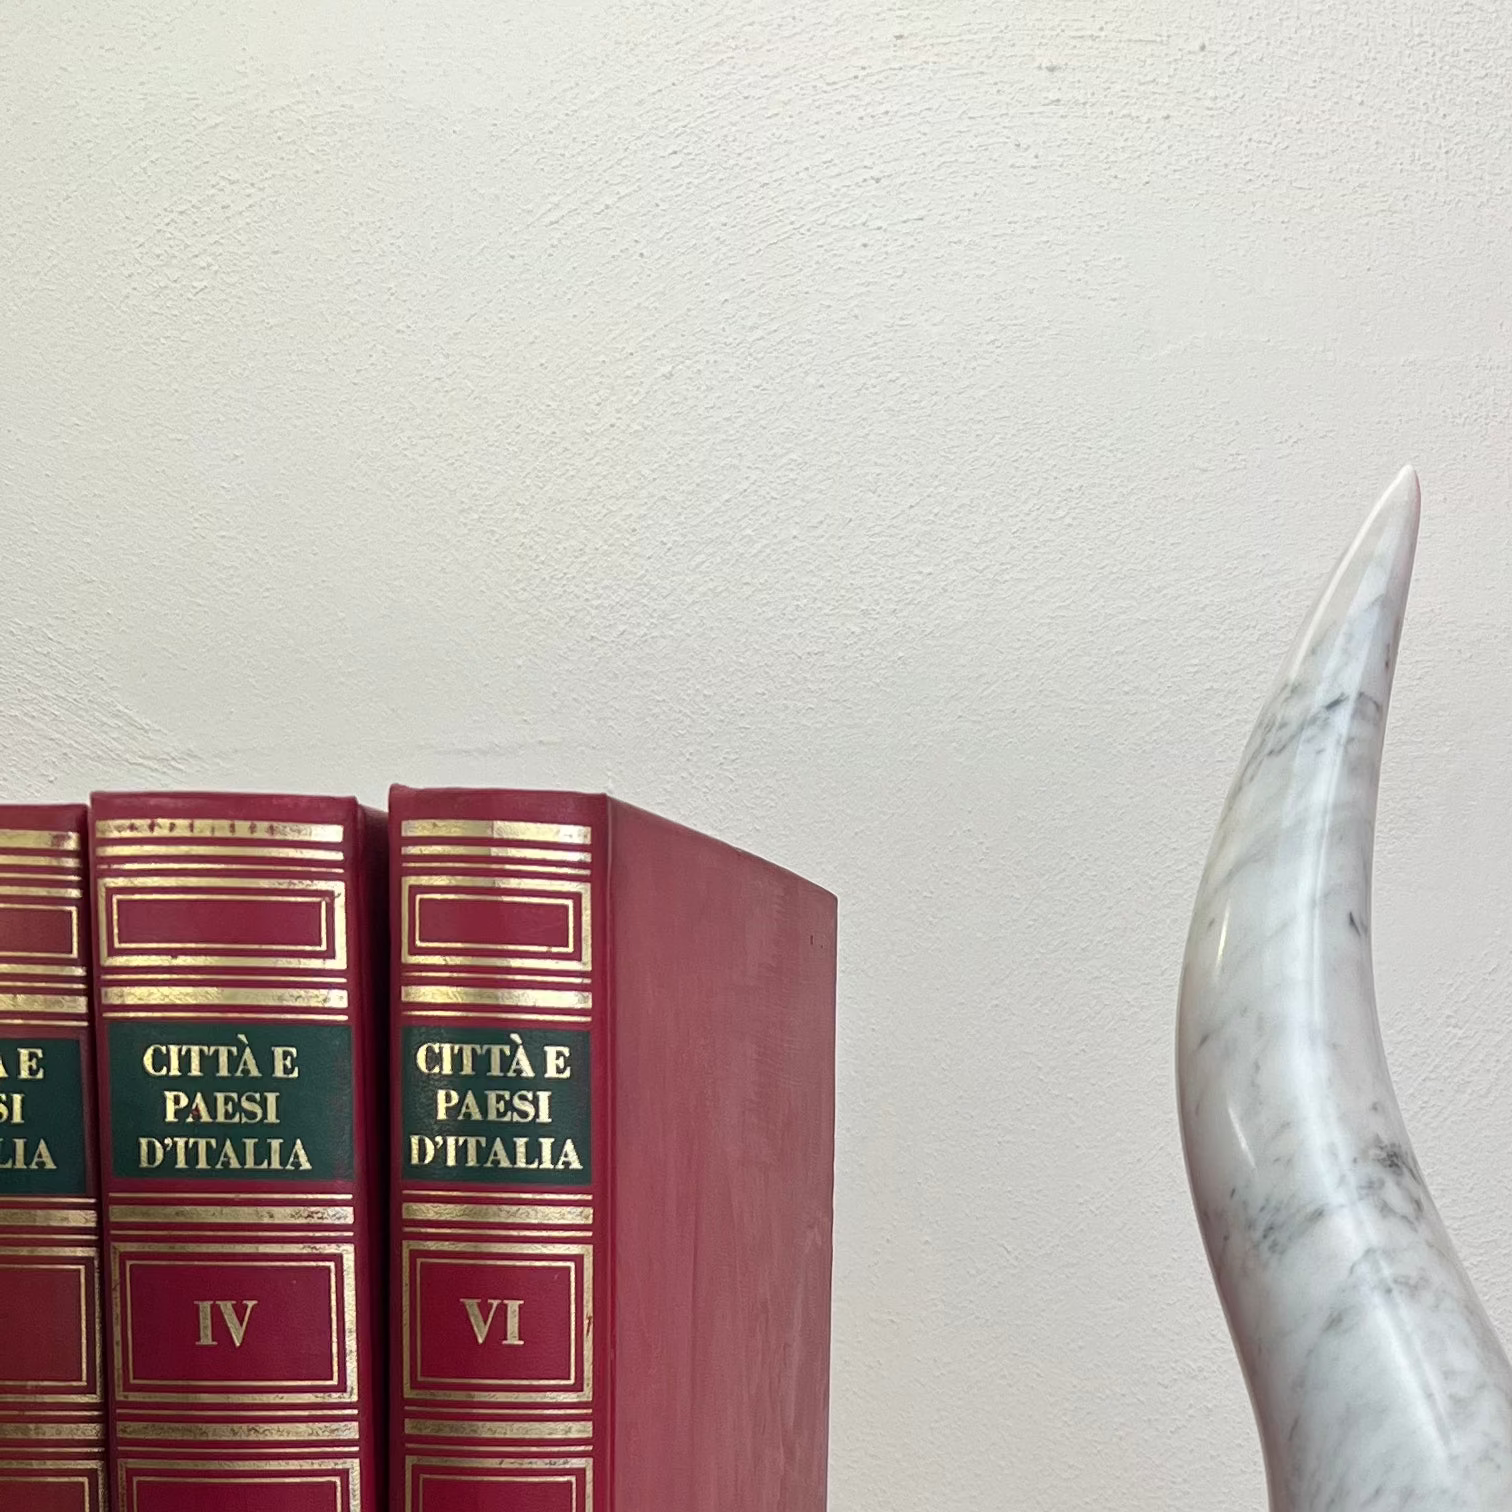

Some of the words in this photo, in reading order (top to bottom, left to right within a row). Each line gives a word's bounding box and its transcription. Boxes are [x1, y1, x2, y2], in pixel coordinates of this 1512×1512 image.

[17, 1048, 45, 1079] E
[143, 1034, 262, 1078] CITTÀ
[272, 1047, 298, 1078] E
[416, 1033, 536, 1080] CITTÀ
[545, 1047, 572, 1079] E
[164, 1091, 279, 1124] PAESI
[436, 1090, 552, 1122] PAESI
[138, 1138, 312, 1171] D'ITALIA
[409, 1136, 583, 1170] D'ITALIA
[194, 1300, 258, 1347] IV
[460, 1298, 525, 1345] VI
